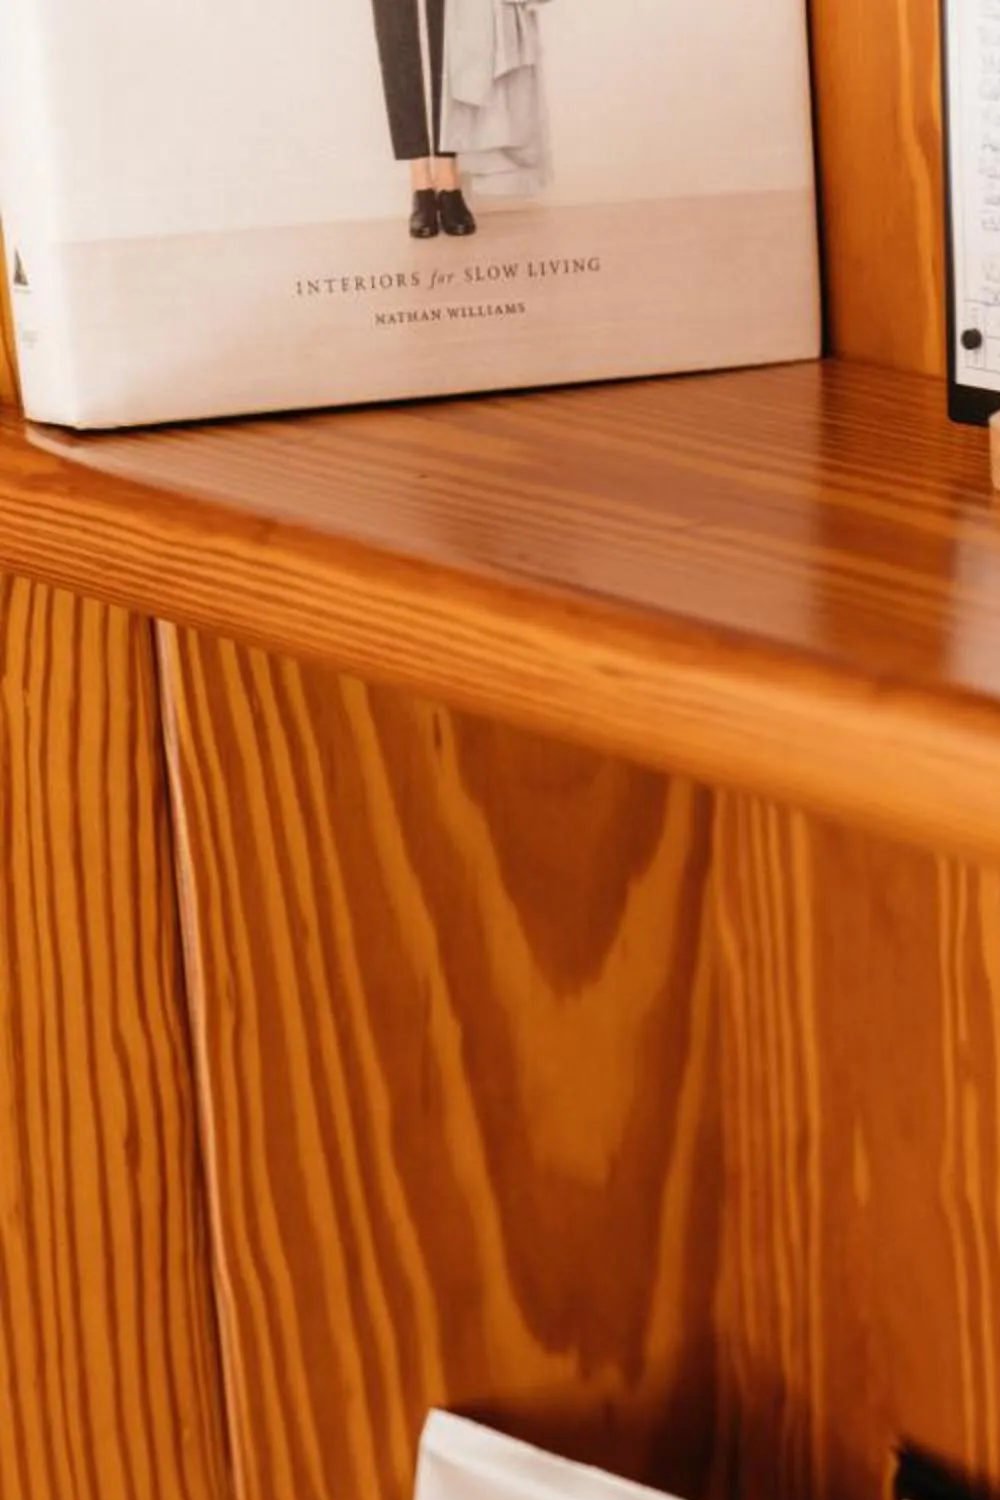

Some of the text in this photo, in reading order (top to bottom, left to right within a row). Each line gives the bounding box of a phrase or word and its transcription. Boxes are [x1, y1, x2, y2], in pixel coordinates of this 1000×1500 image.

[296, 256, 603, 295] INTERIORS for SLOW LIVING
[375, 302, 526, 326] NATHAN WILLIAMS
